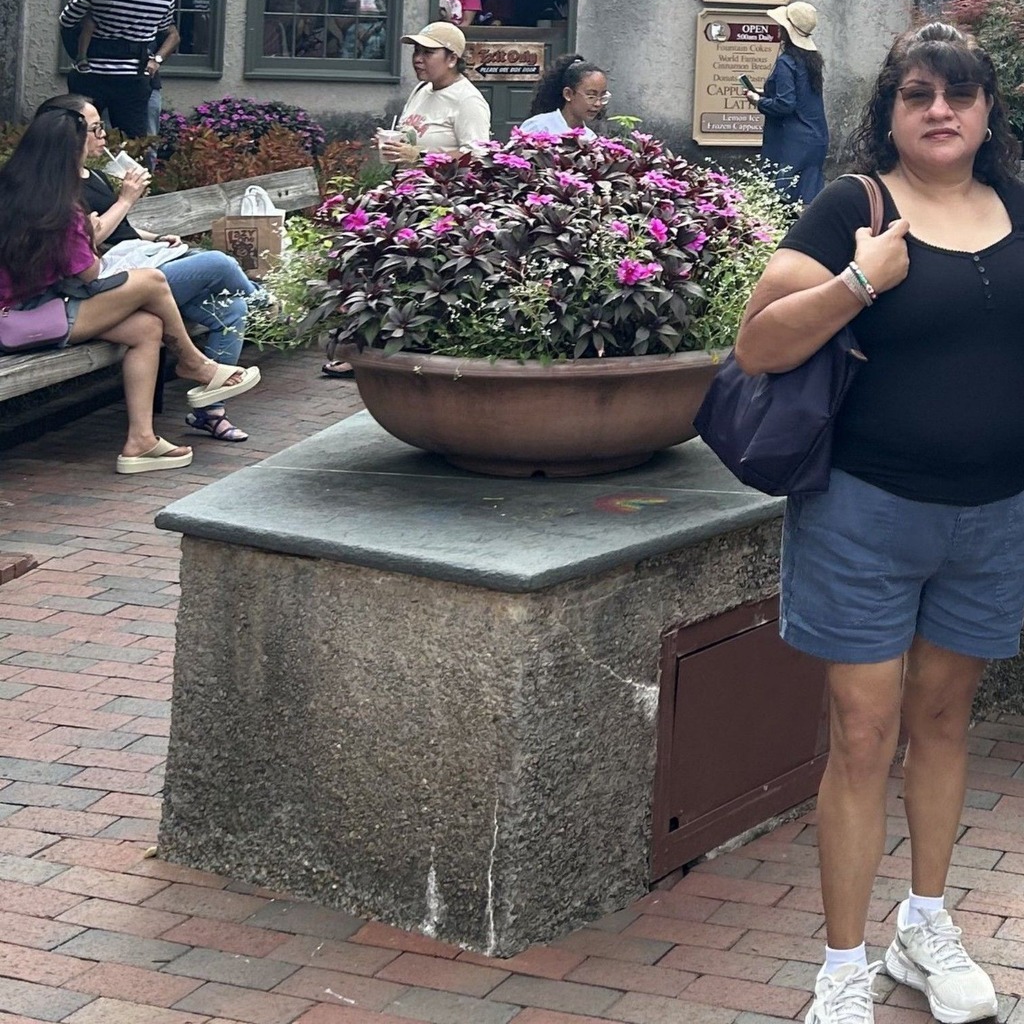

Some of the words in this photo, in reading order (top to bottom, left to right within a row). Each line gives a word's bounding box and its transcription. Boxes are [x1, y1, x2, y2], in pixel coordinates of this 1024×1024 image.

[742, 25, 769, 33] OPEN
[758, 34, 774, 42] Daily
[716, 44, 748, 52] Fountain
[749, 44, 772, 52] Cokes
[718, 54, 739, 63] World
[741, 55, 768, 63] Famous
[713, 62, 749, 70] Cinnamon
[751, 62, 772, 70] Bread
[722, 114, 747, 122] Lemon
[707, 122, 731, 130] Frozen
